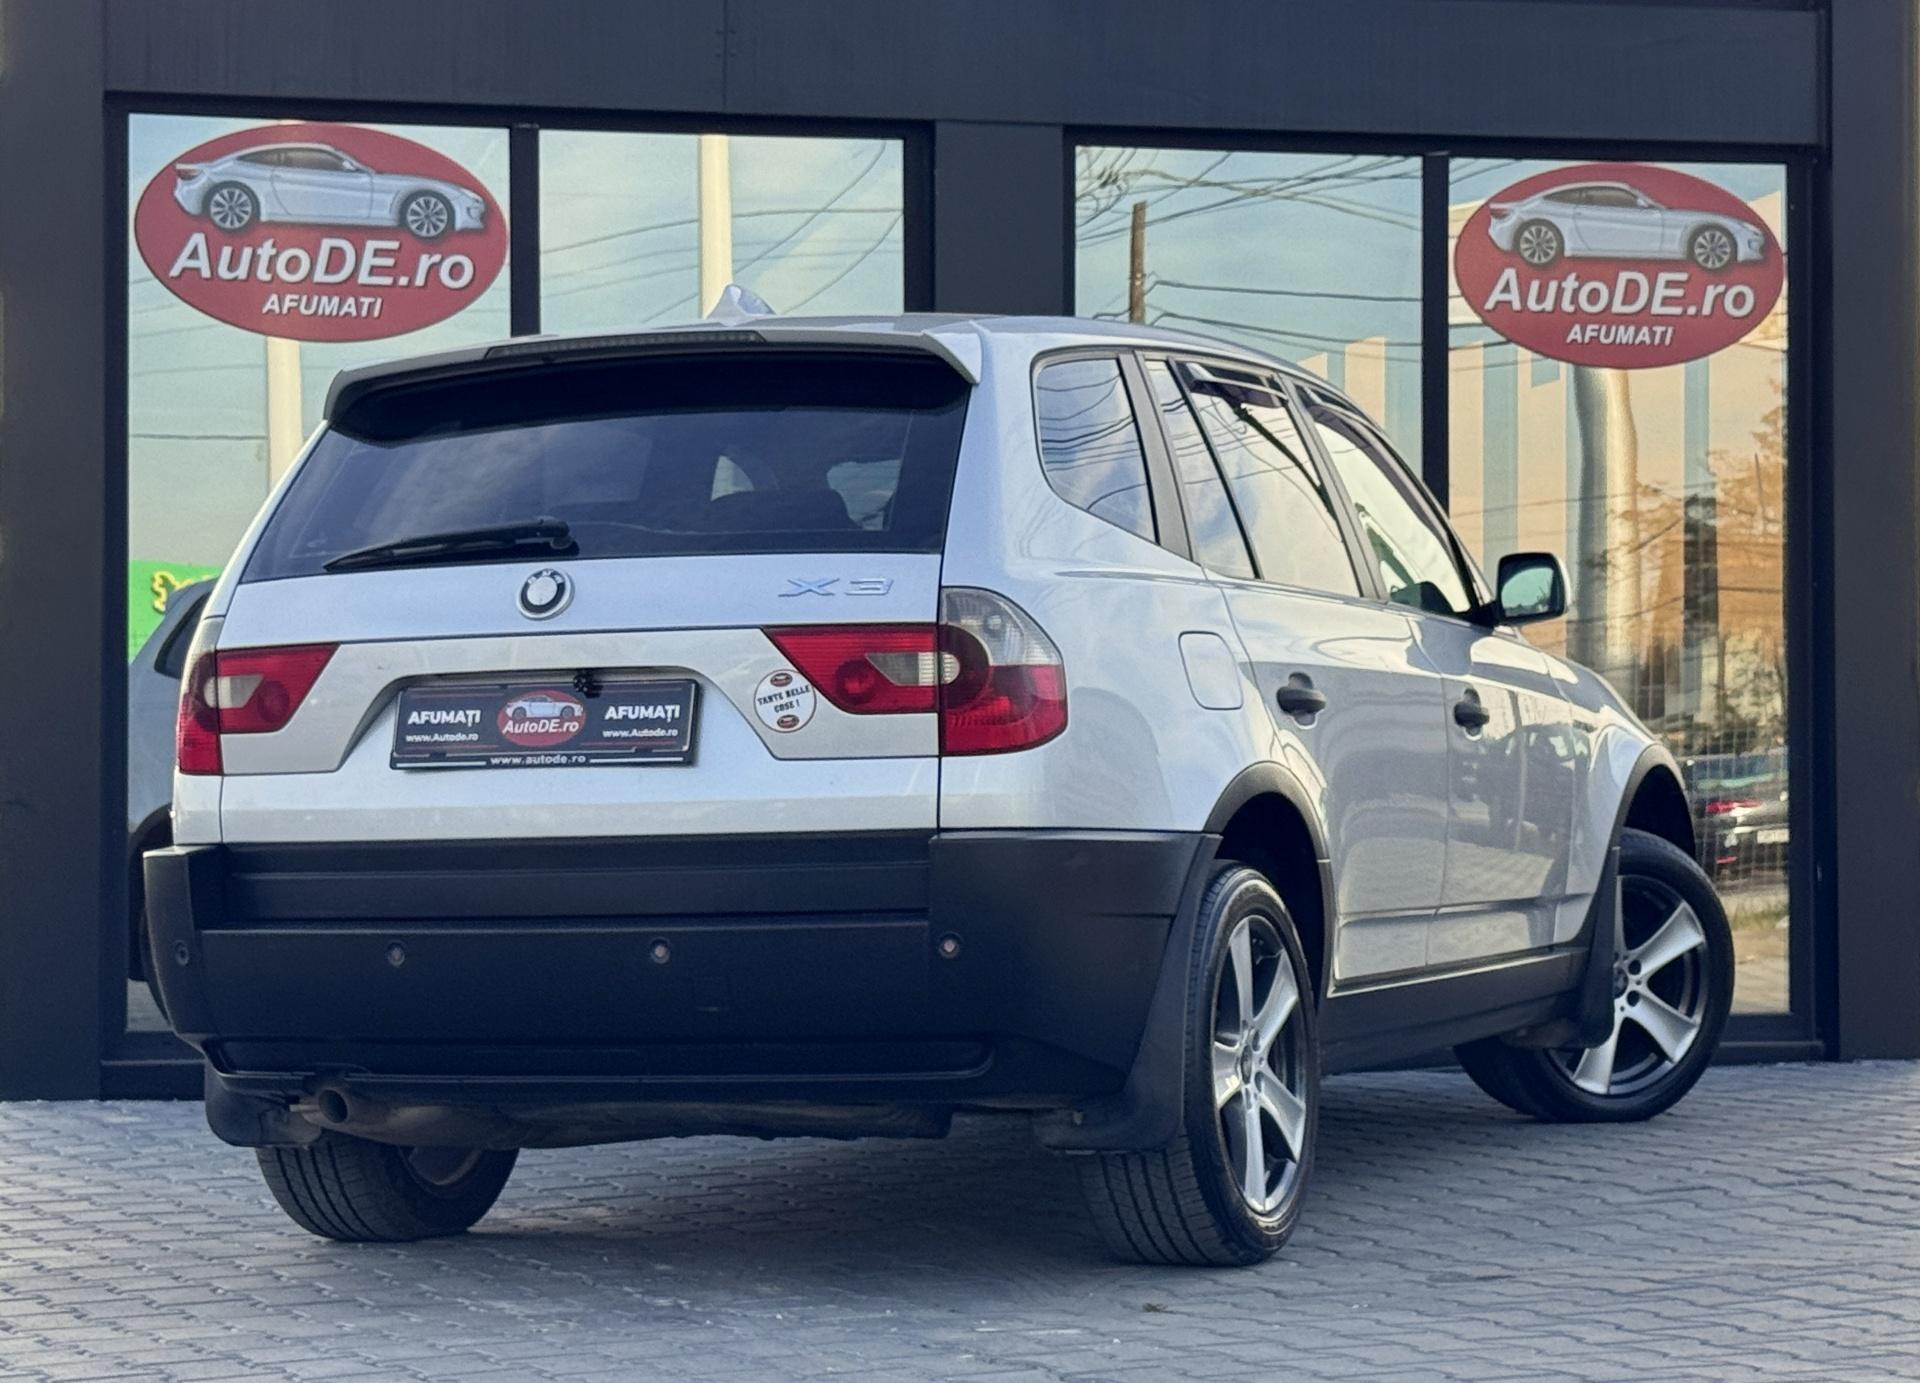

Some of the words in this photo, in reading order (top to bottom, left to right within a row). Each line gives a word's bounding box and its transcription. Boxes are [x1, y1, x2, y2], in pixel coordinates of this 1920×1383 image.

[169, 232, 476, 290] AutoDE.ro
[1484, 267, 1756, 318] AutoDE.ro
[262, 293, 383, 318] AFUMATI
[1566, 323, 1674, 346] AFUMATI
[501, 718, 580, 735] AutoDE.ro
[490, 754, 586, 765] www.autode.ro
